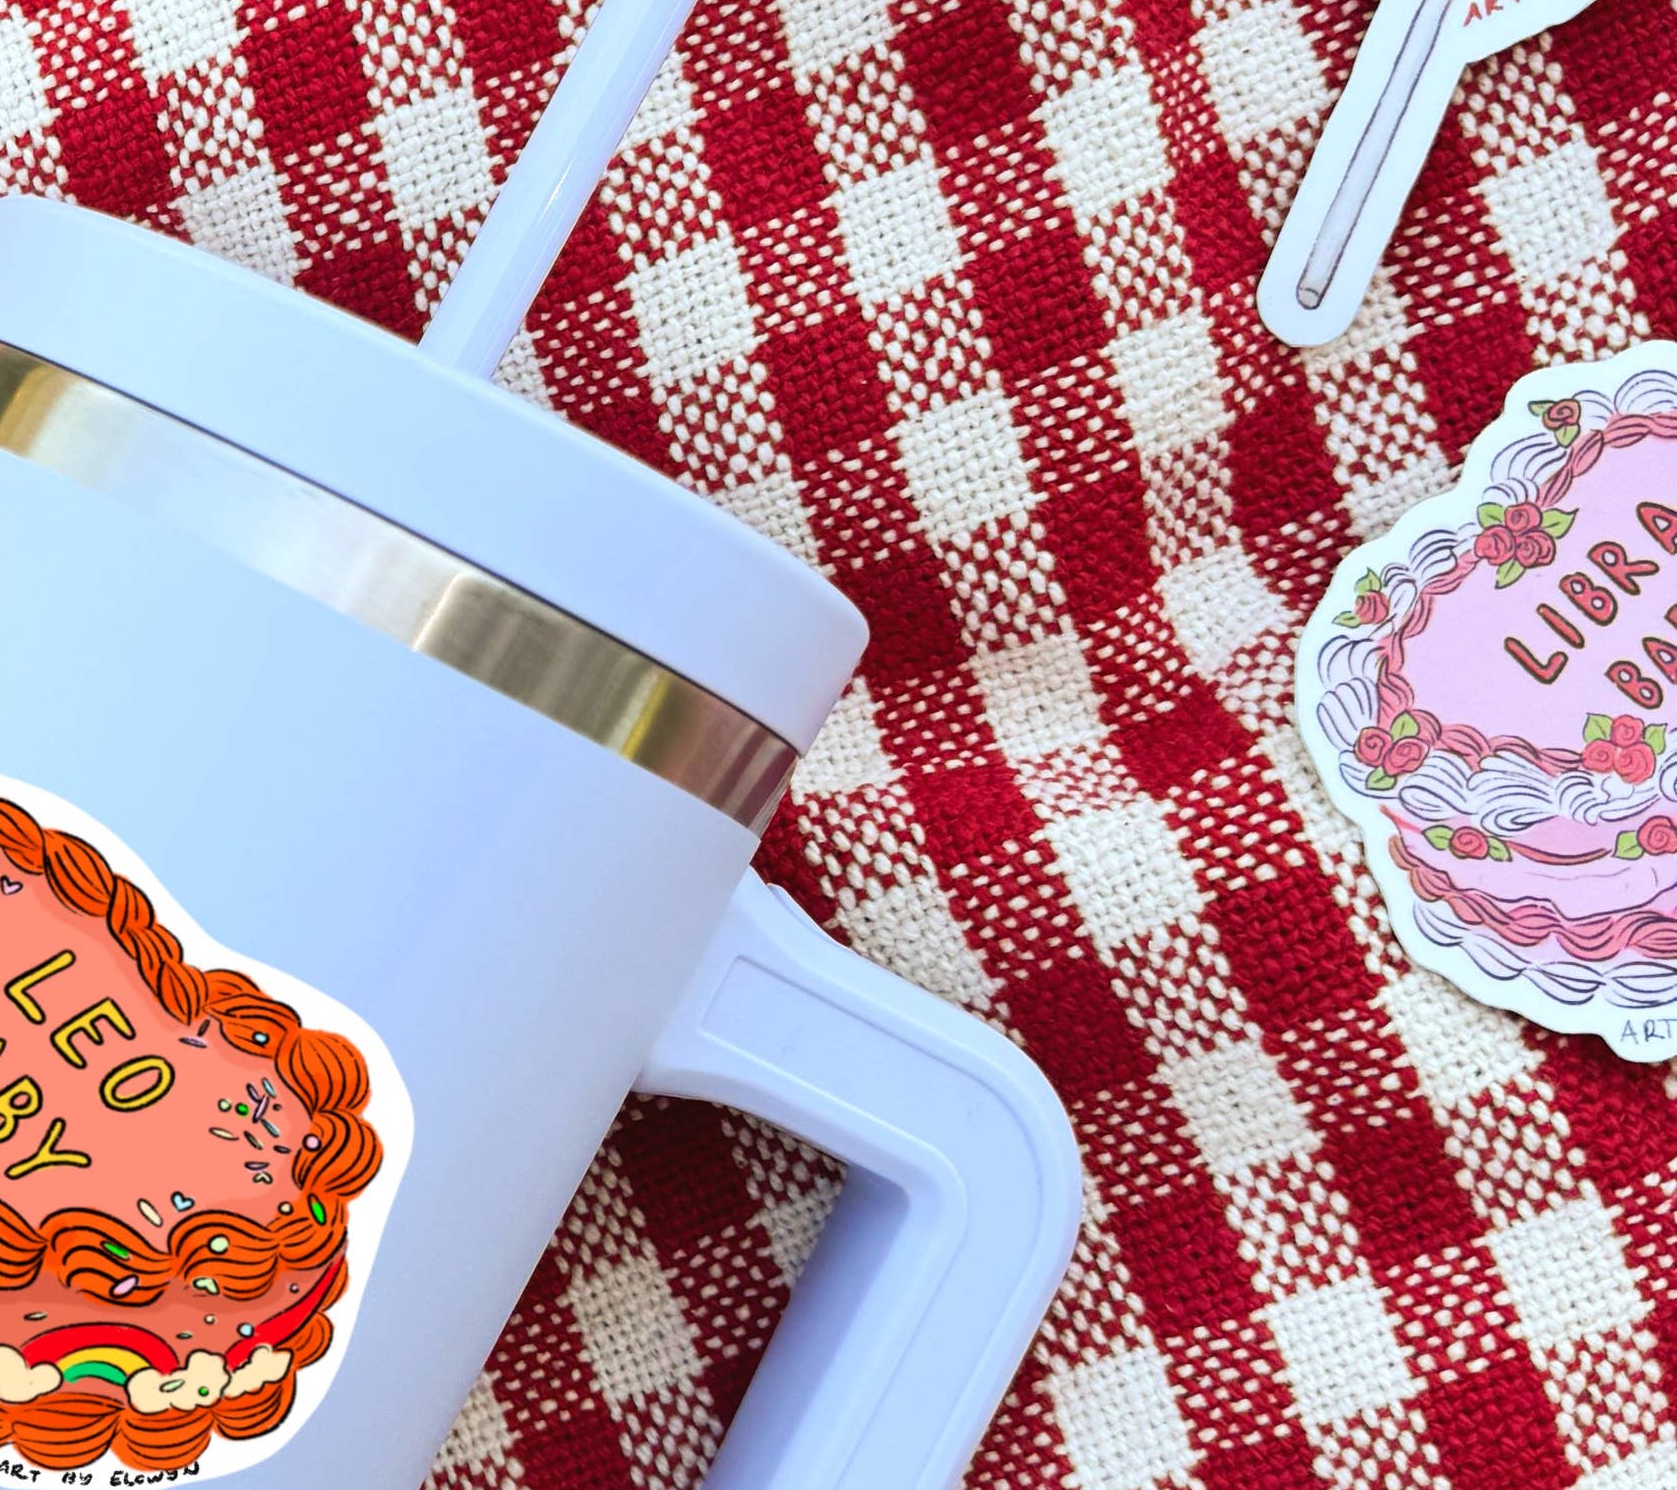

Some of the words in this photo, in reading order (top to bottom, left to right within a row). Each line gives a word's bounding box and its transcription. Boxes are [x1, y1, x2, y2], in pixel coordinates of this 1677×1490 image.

[1503, 501, 1677, 685] LIBRA
[3, 949, 176, 1114] LEO
[1619, 1018, 1677, 1045] ART
[61, 1471, 93, 1486] BY
